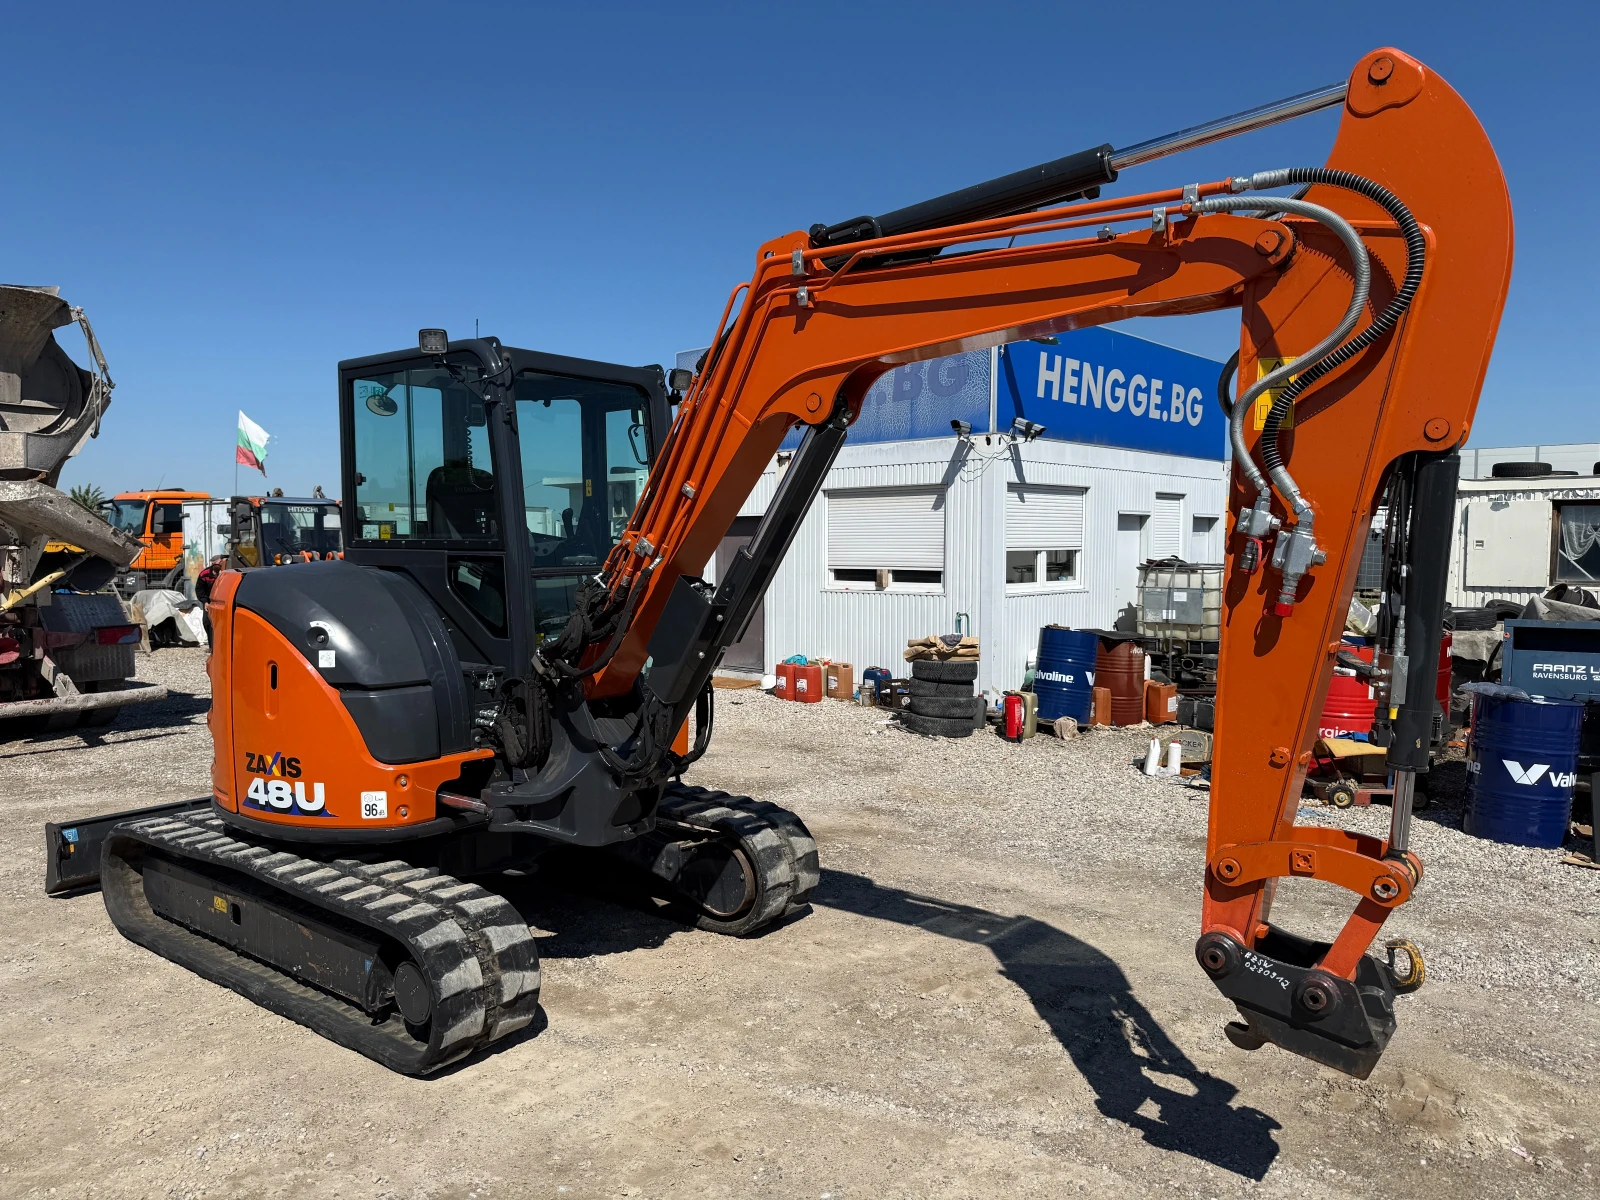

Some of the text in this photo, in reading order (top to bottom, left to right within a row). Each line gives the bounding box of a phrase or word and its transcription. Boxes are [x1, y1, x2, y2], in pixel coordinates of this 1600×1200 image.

[864, 354, 969, 407] .BG
[1037, 351, 1204, 427] HENGGE.BG
[1034, 669, 1075, 684] alvoline
[1533, 663, 1587, 674] FRANZ
[1533, 672, 1588, 681] RAVENSBURG
[245, 751, 302, 779] ZAXIS
[1549, 771, 1577, 788] Valv
[247, 777, 326, 814] 48U
[364, 803, 378, 817] 96
